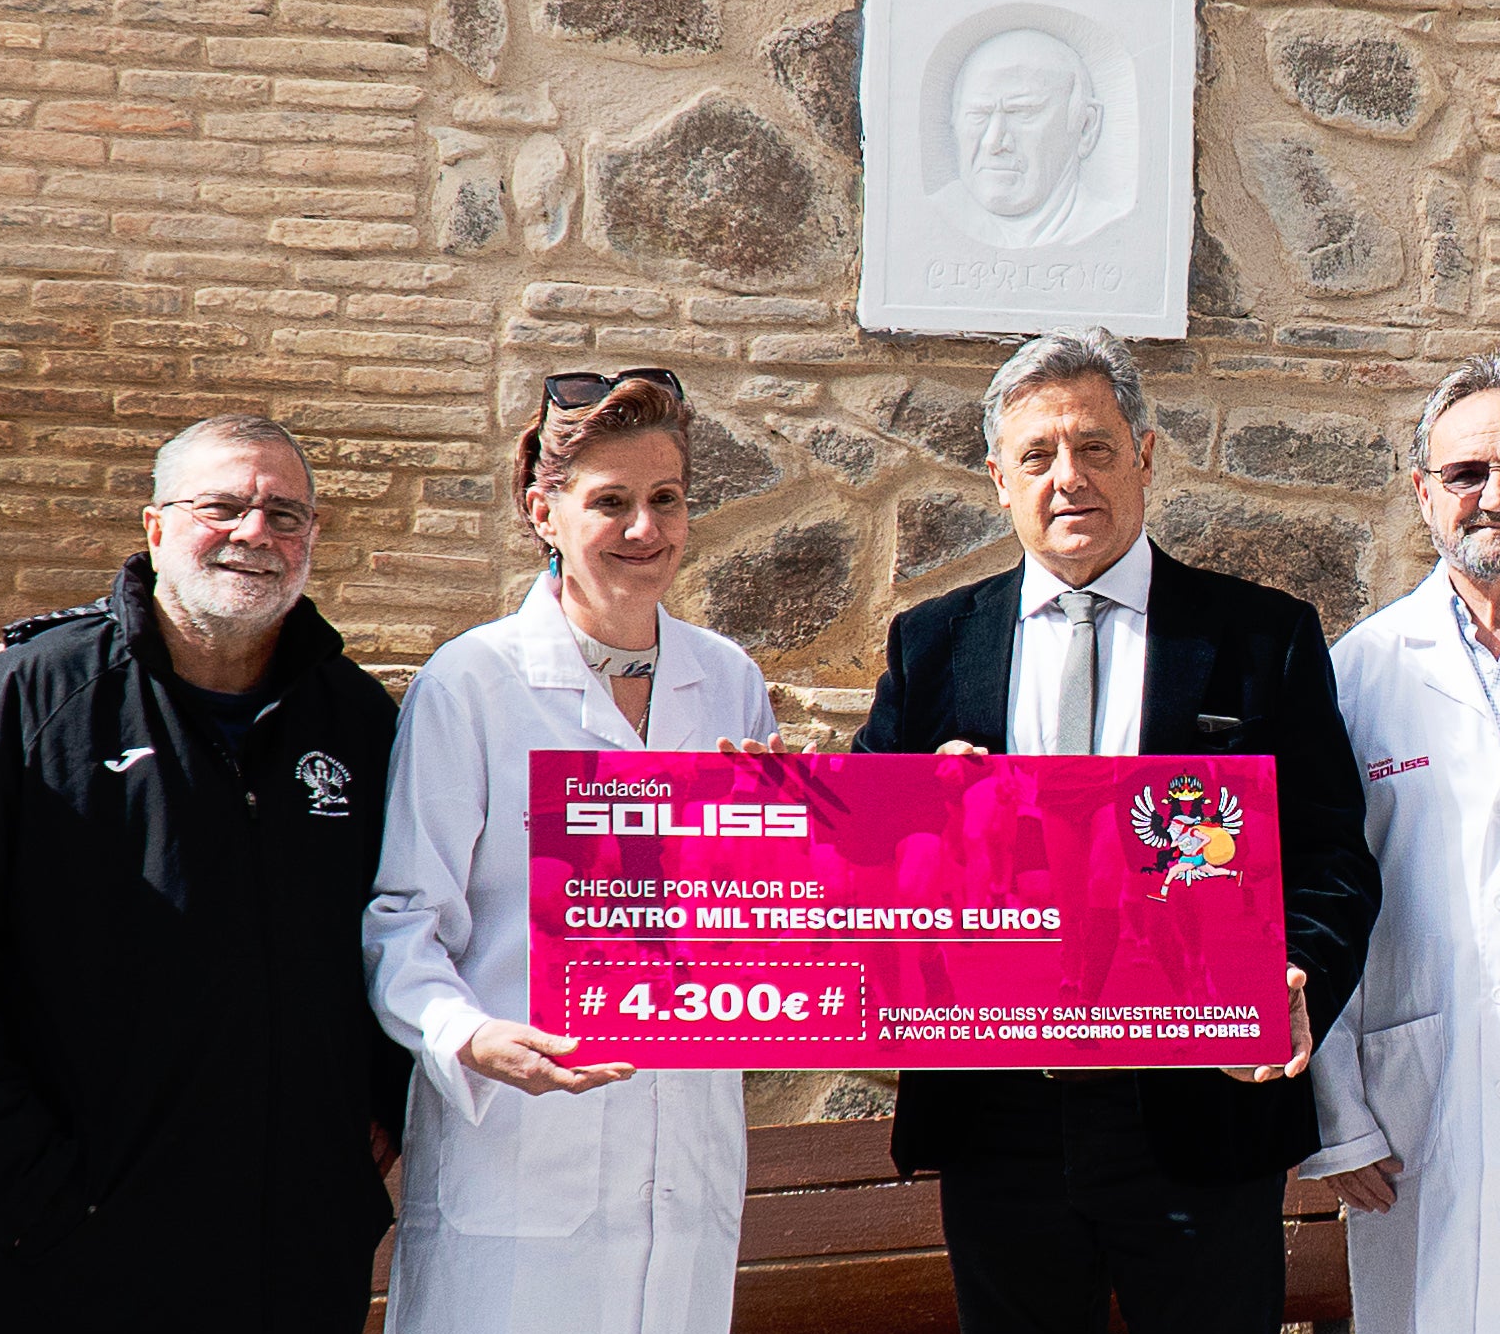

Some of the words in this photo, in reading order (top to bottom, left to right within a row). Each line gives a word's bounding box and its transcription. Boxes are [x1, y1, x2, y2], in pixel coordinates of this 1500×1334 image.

[926, 260, 1123, 292] CIPRIANO
[1369, 756, 1429, 781] SOLISS
[567, 778, 670, 796] Fundación
[567, 803, 807, 836] SOLISS
[566, 880, 655, 897] CHEQUE
[664, 881, 707, 898] POR
[712, 881, 783, 898] VALOR
[791, 882, 824, 898] DE:
[566, 907, 686, 928] CUATRO
[697, 908, 749, 928] MIL
[752, 908, 952, 929] TRESCIENTOS
[963, 909, 1060, 929] EUROS
[620, 984, 809, 1021] 4.300€
[880, 1005, 974, 1021] FUNDACIÓN
[979, 1008, 1036, 1021] SOLISS
[1038, 1008, 1048, 1020] Y
[1053, 1008, 1086, 1020] SAN
[1091, 1007, 1172, 1020] SILVESTRE
[1174, 1006, 1259, 1019] TOLEDANA
[879, 1027, 891, 1039] A
[896, 1026, 945, 1039] FAVOR
[950, 1026, 970, 1039] DE
[975, 1026, 995, 1039] LA
[999, 1026, 1037, 1039] ONG
[1042, 1025, 1124, 1039] SOCORRO
[1130, 1025, 1152, 1038] DE
[1157, 1025, 1189, 1038] LOS
[1195, 1024, 1260, 1037] POBRES
